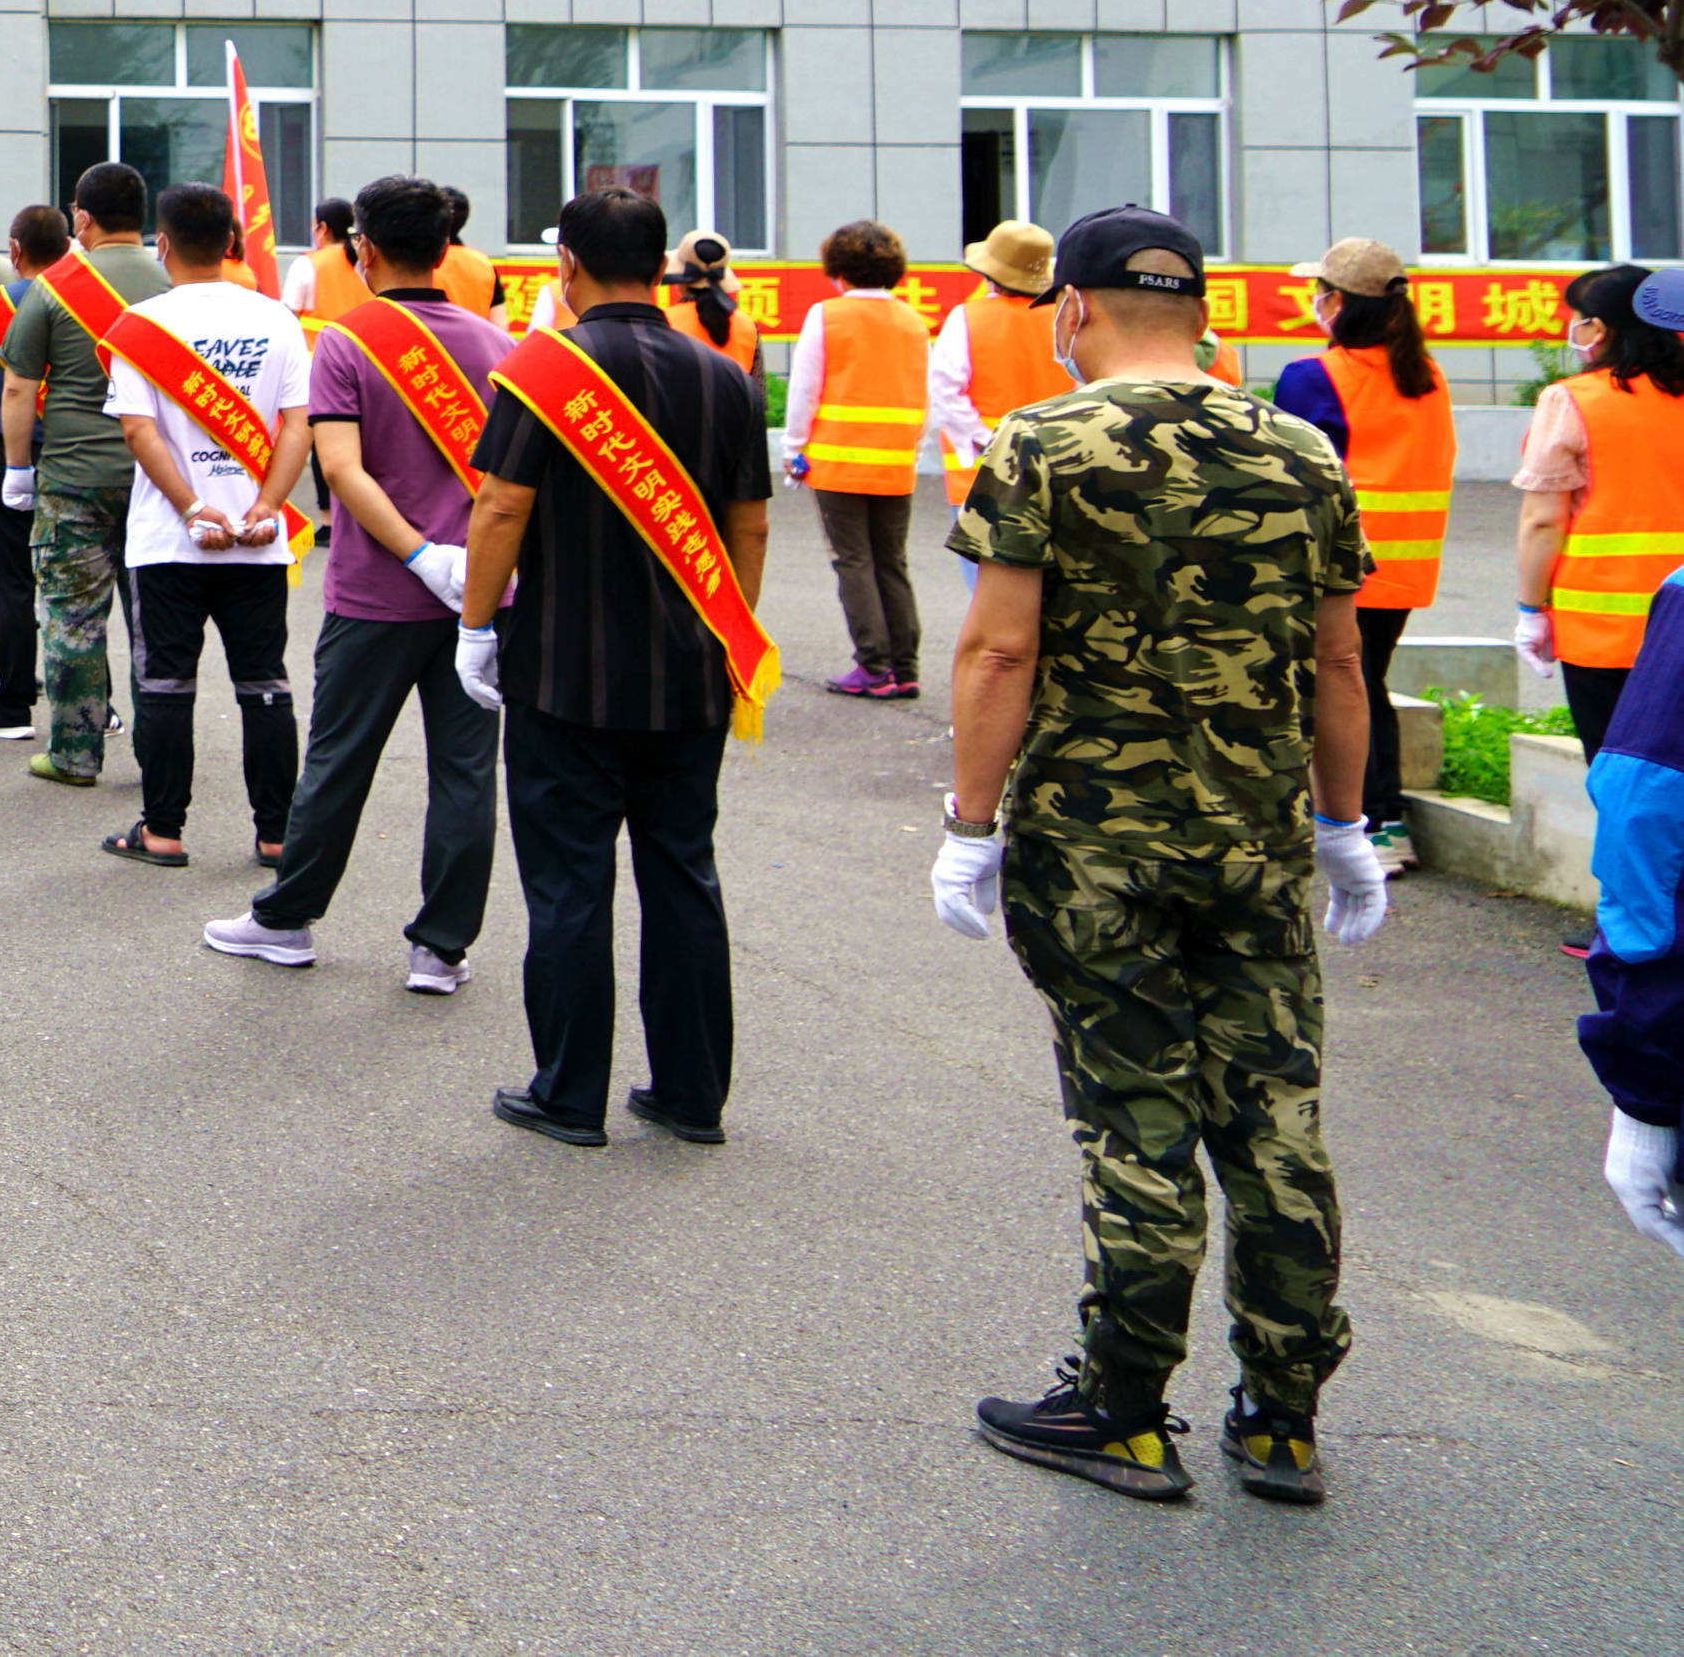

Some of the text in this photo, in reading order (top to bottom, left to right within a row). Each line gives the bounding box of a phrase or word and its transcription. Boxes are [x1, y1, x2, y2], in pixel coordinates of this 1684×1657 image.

[563, 389, 722, 600] 新时代文明实践志愿者
